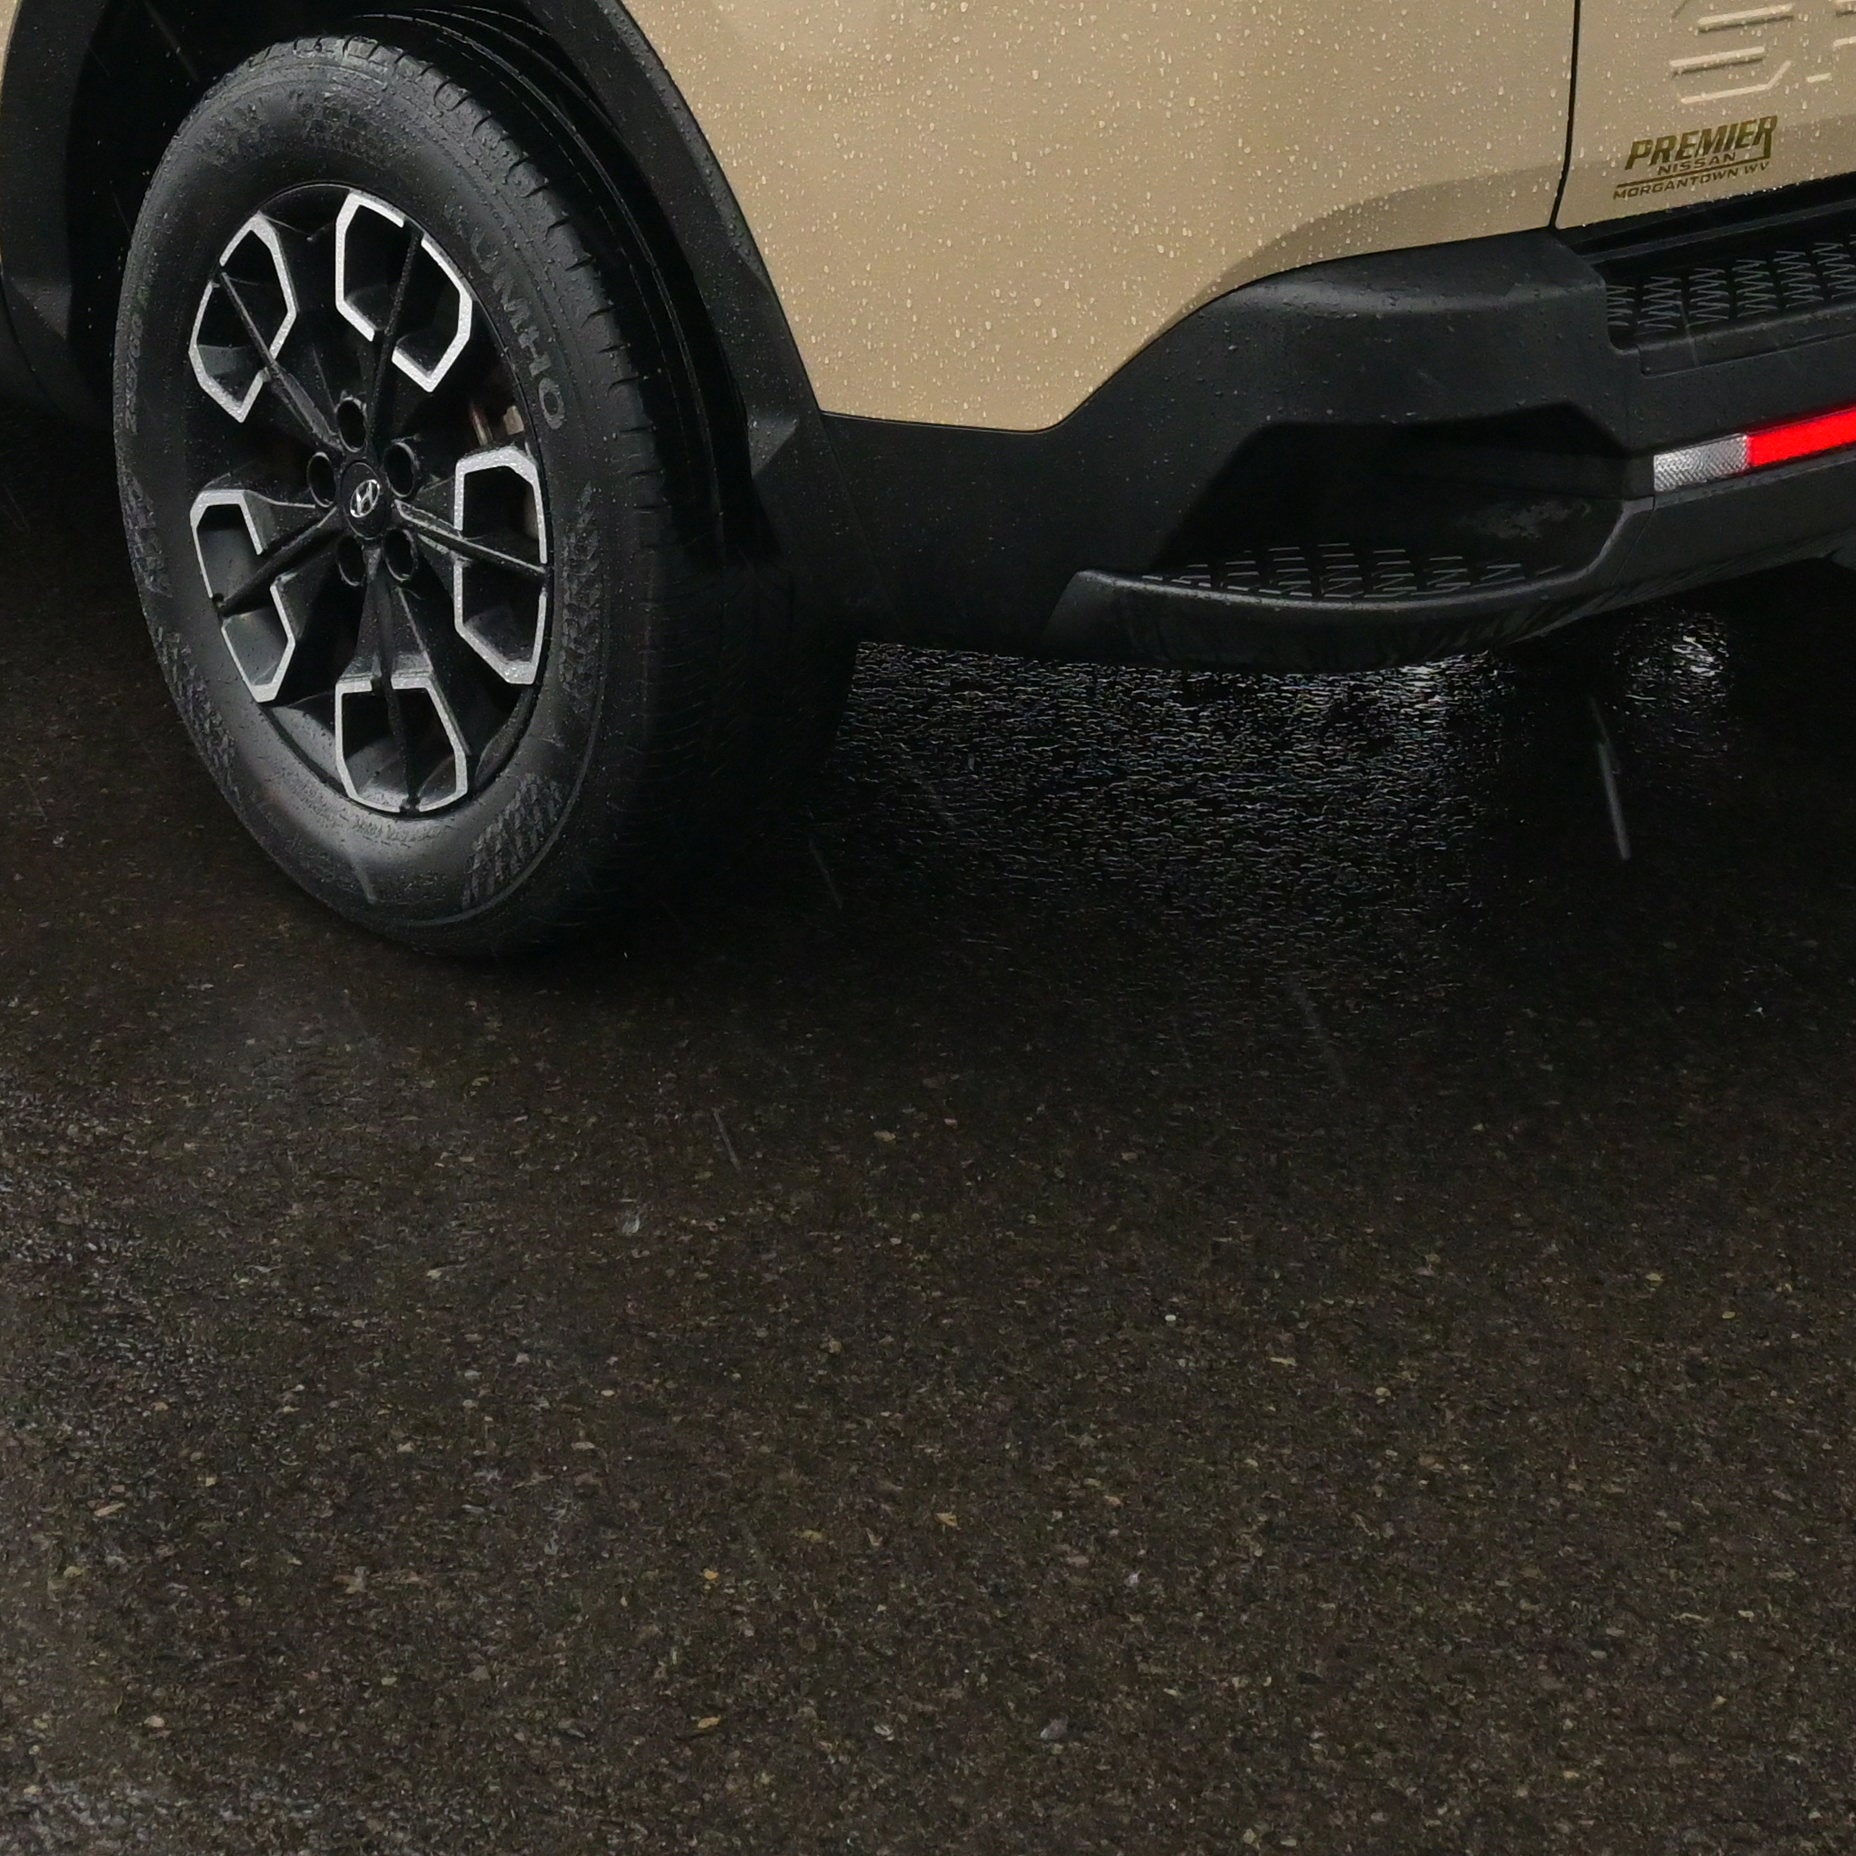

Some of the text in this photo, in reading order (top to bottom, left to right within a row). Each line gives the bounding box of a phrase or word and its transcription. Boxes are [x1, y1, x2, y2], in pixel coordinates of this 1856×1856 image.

[1625, 115, 1777, 170] PREMIER
[1612, 161, 1771, 200] MORGANTOWN WV
[1657, 151, 1736, 175] NISSAN
